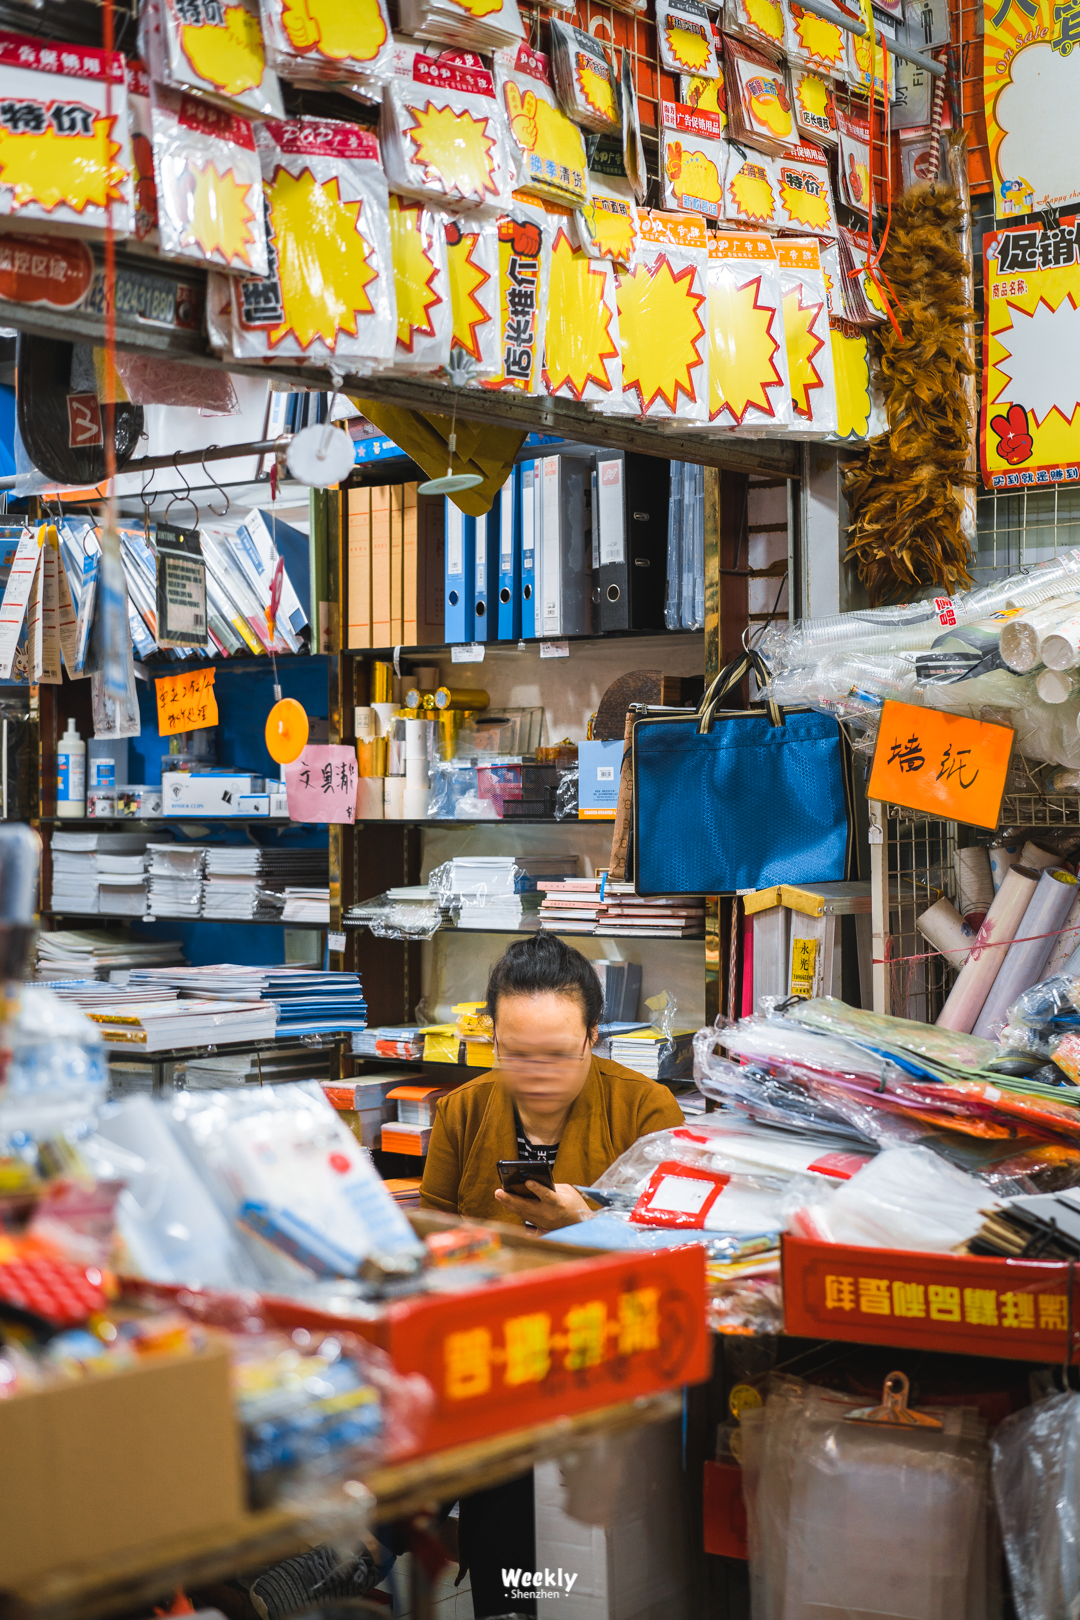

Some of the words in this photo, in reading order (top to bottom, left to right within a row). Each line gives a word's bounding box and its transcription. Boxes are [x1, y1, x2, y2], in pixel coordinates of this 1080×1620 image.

[1015, 25, 1050, 49] Sale
[0, 101, 95, 134] 特价
[677, 112, 720, 135] 广告促销用品
[802, 111, 830, 131] 店长推荐
[529, 153, 583, 191] 换季清货
[785, 172, 820, 196] 特价
[1036, 193, 1067, 206] Happy
[992, 279, 1028, 299] 商品名称:
[887, 733, 980, 790] 墙纸
